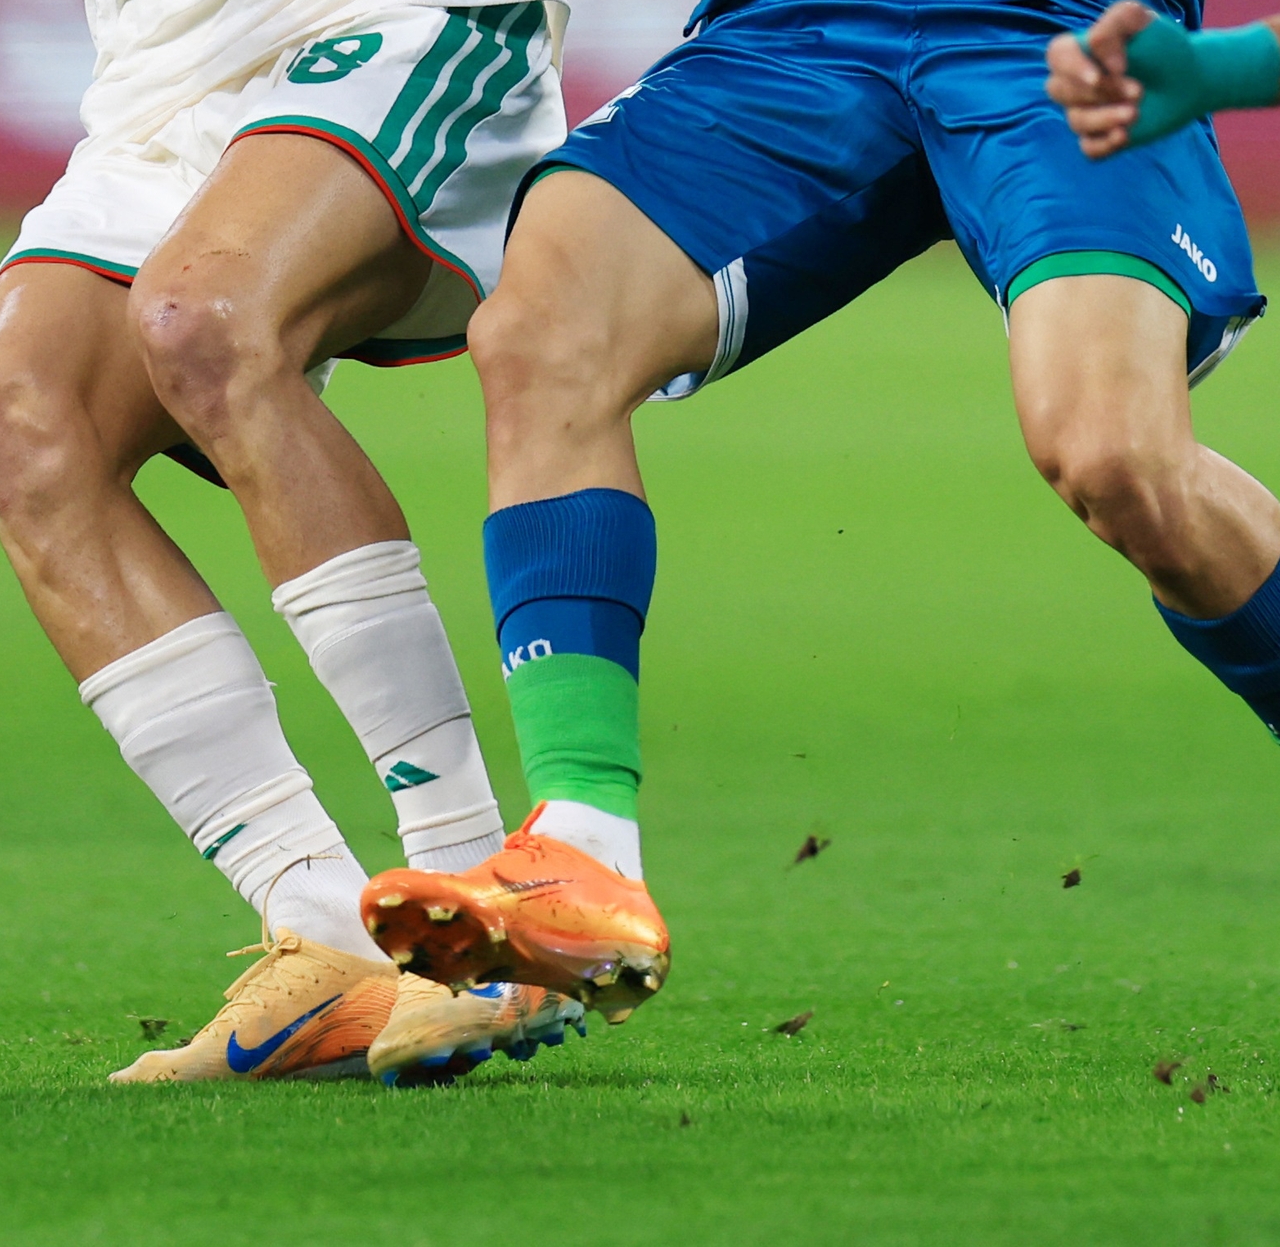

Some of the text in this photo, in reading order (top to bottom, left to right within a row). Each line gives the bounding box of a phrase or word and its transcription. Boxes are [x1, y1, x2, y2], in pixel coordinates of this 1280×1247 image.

[285, 32, 383, 84] 8
[1171, 223, 1218, 283] JAKO
[501, 638, 553, 684] AKO
